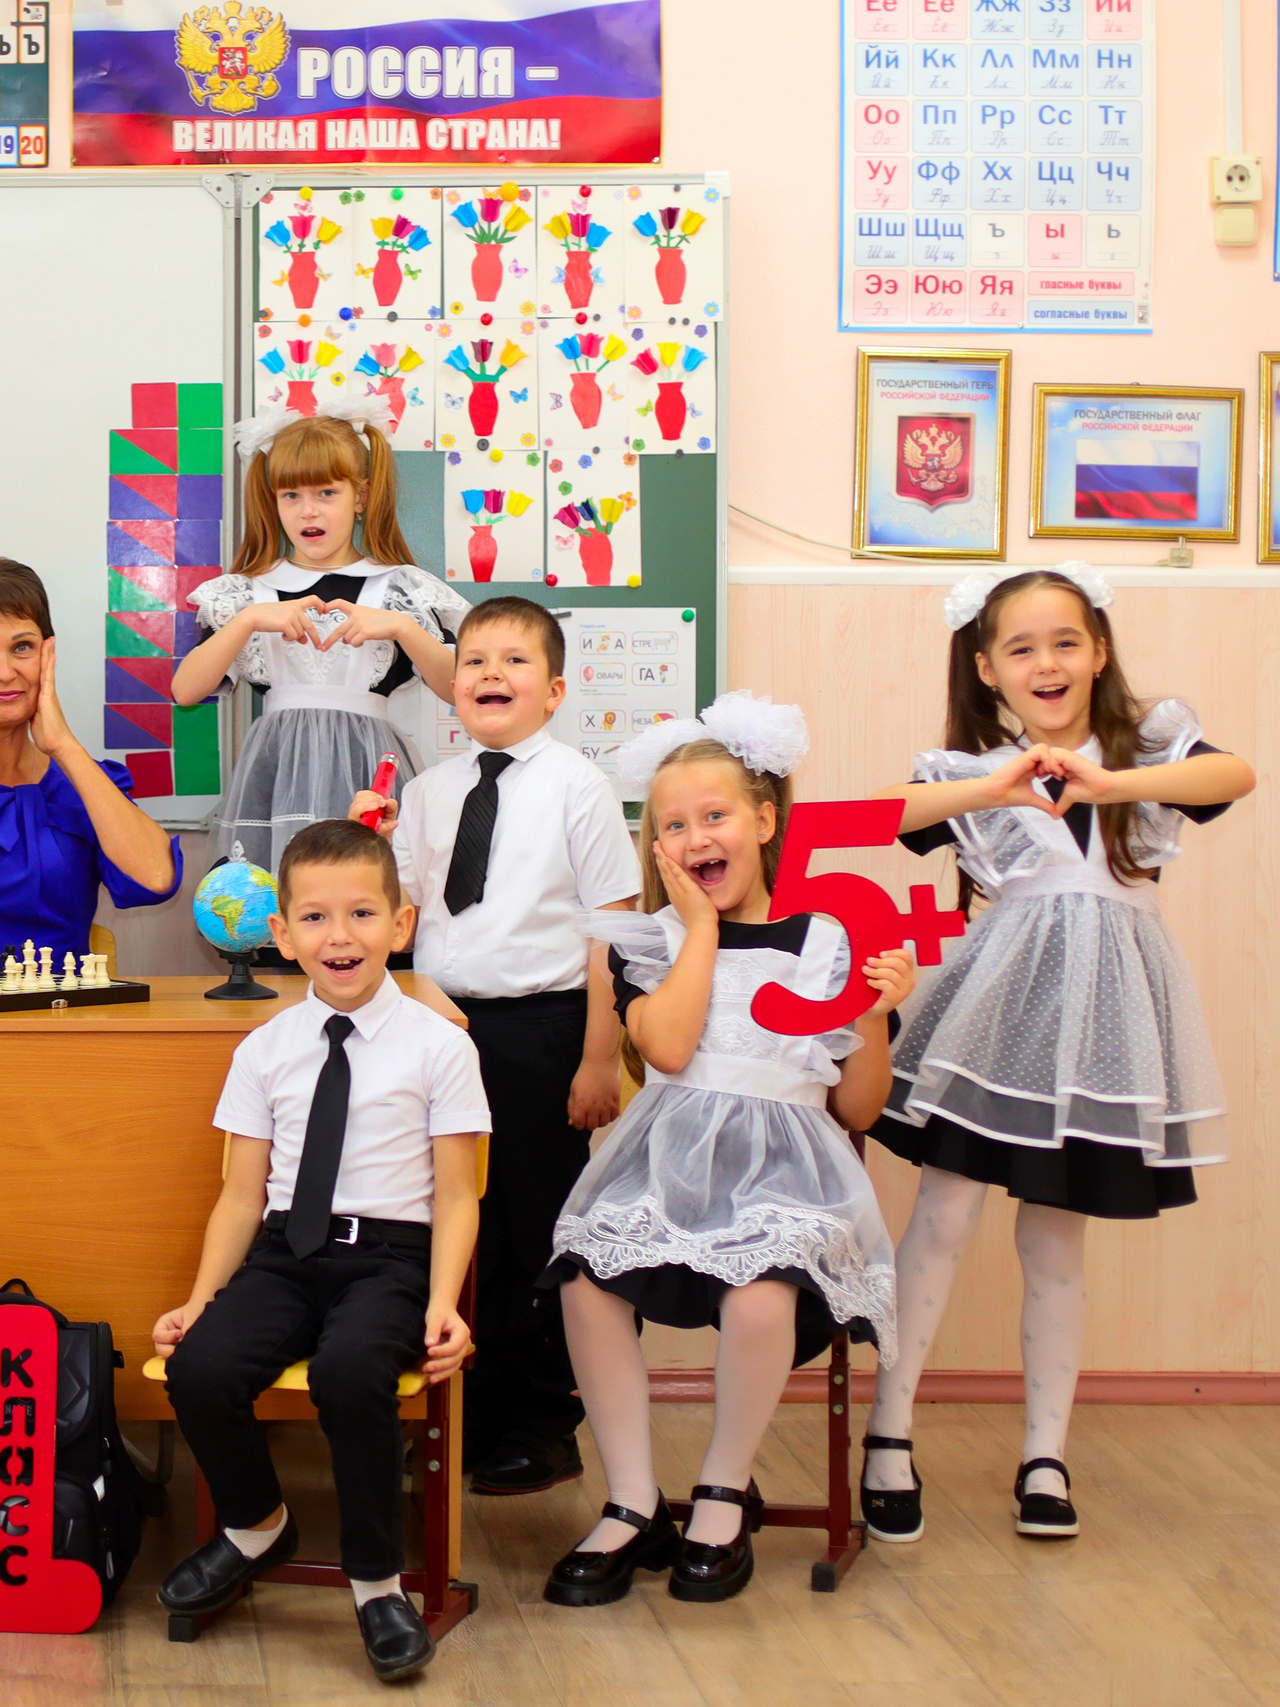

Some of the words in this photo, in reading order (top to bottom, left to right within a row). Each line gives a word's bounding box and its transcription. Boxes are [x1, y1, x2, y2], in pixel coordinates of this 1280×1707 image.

[865, 45, 899, 68] Йй
[923, 48, 956, 68] Кк
[981, 49, 1014, 68] Лл
[1033, 49, 1079, 68] Мм
[1097, 49, 1132, 68] Нн
[297, 46, 514, 98] РОССИЯ
[864, 104, 900, 124] Оо
[923, 105, 956, 124] Пп
[981, 105, 1015, 129] Рр
[1038, 105, 1072, 125] Сс
[1098, 105, 1127, 125] Тт
[174, 120, 317, 151] ВЕЛИКАЯ
[326, 119, 420, 149] НАША
[426, 118, 561, 149] СТРАНА!
[20, 135, 43, 154] 20
[866, 160, 897, 185] Уу
[917, 160, 960, 185] Фф
[982, 160, 1013, 180] Хх
[1038, 161, 1074, 185] Цц
[1097, 161, 1129, 181] Чч
[858, 217, 905, 236] Шш
[916, 218, 964, 240] Щщ
[865, 274, 898, 294] Ээ
[915, 275, 962, 294] Юю
[980, 275, 1013, 295] Яя
[1040, 280, 1084, 289] гласные
[1088, 279, 1122, 291] буквы
[1034, 310, 1090, 319] согласные
[1094, 309, 1128, 320] буквы
[876, 379, 968, 389] ГОСУДАРСТВЕННЫЙ
[971, 381, 994, 390] ГЕРБ
[880, 391, 936, 400] РОССИЙСКОЙ
[939, 393, 990, 402] ФЕДЕРАЦИИ
[1074, 409, 1172, 420] ГОСУДАРСТВЕННЫЙ
[1175, 412, 1201, 421] ФЛАГ
[1082, 421, 1139, 430] РОССИЙСКОЙ
[1142, 423, 1193, 432] ФЕДЕРАЦИИ
[583, 638, 592, 649] И
[615, 638, 624, 649] А
[632, 640, 651, 648] СТРЕ
[596, 672, 623, 680] ОВАРЫ
[640, 667, 655, 681] ГА
